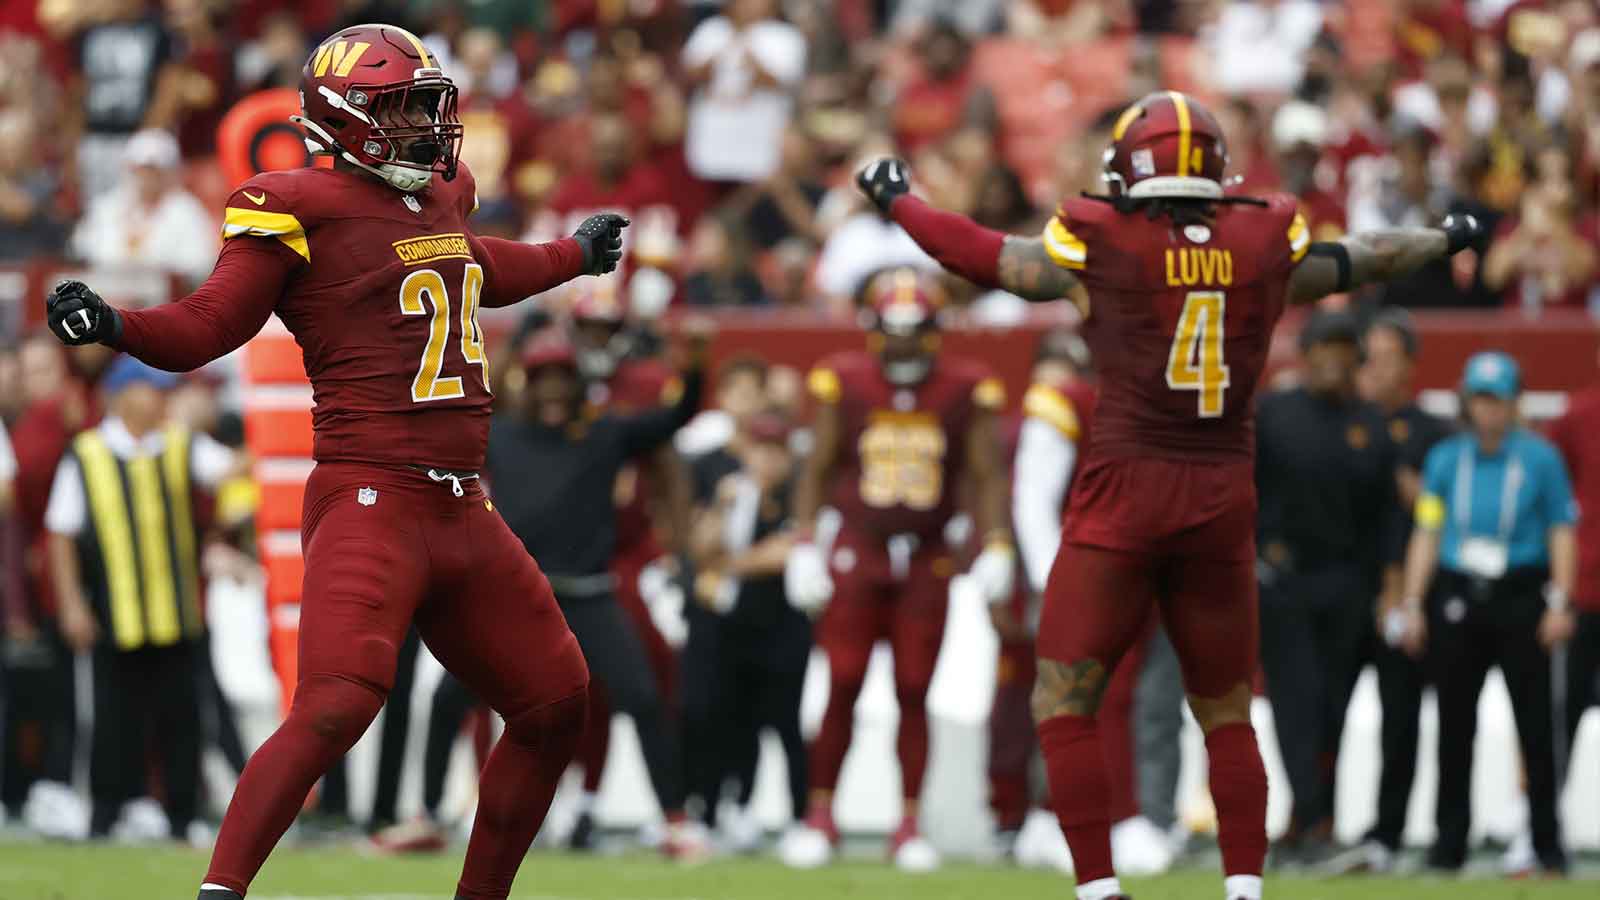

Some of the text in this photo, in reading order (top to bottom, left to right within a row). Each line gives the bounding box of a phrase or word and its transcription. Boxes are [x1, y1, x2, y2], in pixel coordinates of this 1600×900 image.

[1165, 248, 1233, 286] LUVU
[400, 263, 491, 402] 24
[1165, 291, 1230, 418] 4
